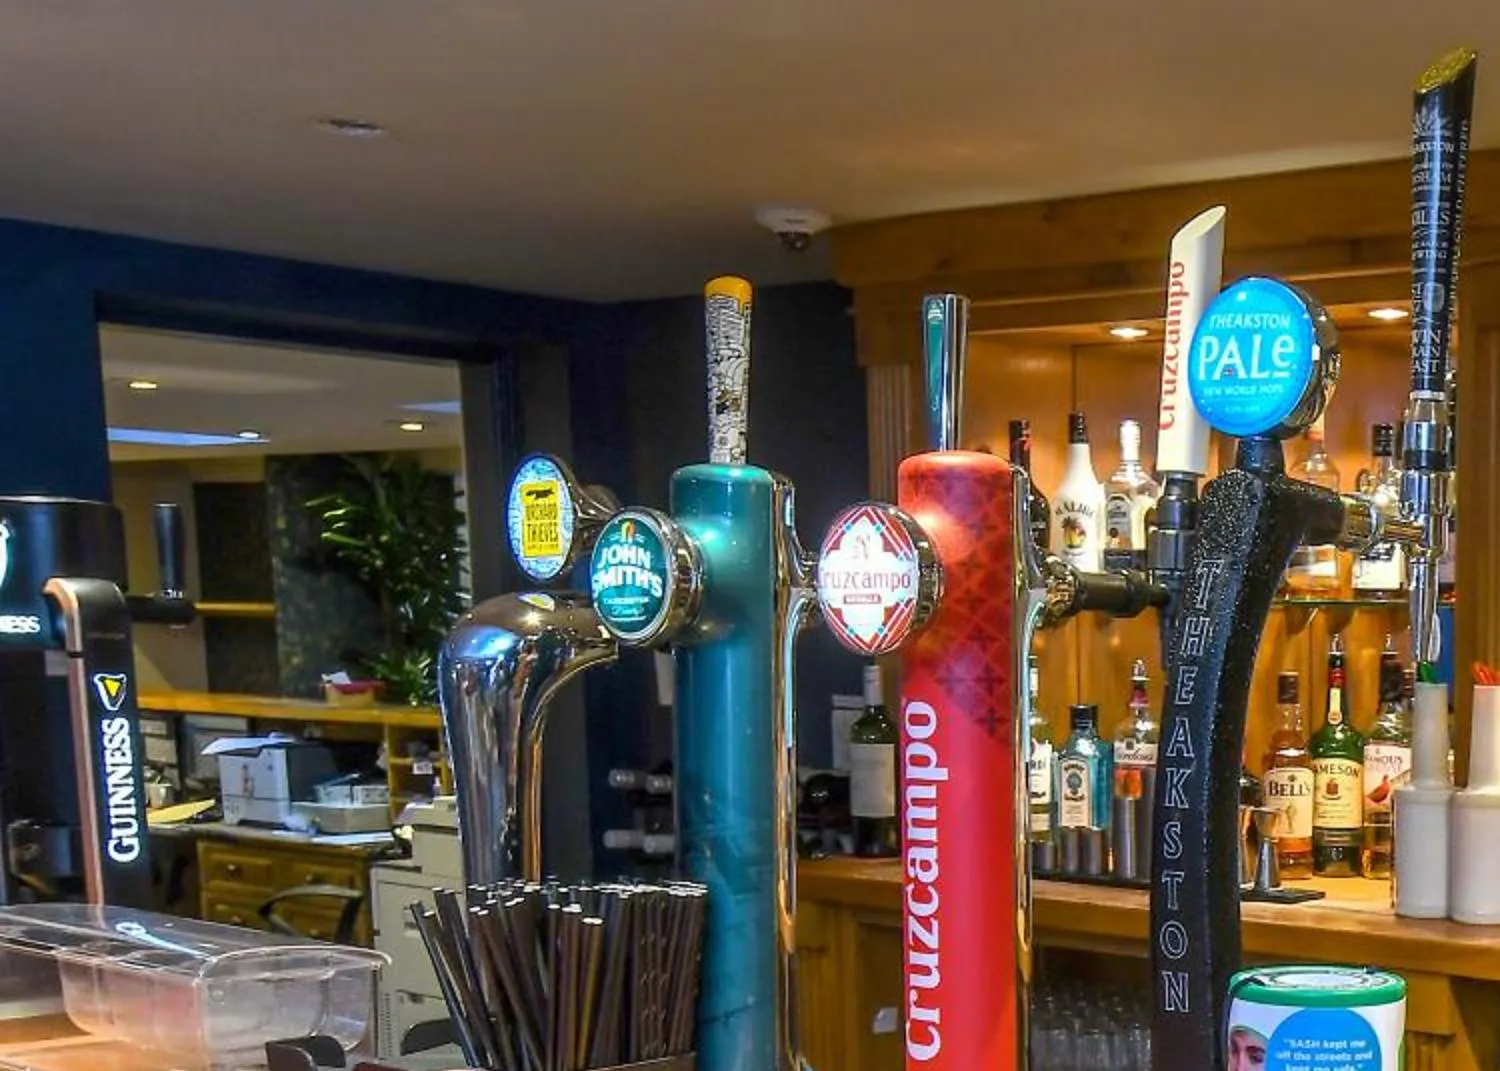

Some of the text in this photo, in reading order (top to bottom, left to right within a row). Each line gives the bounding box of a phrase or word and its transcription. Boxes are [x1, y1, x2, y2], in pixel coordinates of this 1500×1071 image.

[1209, 312, 1292, 331] THEAKSTON
[1158, 261, 1190, 431] Cruzcampo
[597, 544, 651, 570] JOHN
[591, 565, 664, 599] SMITH'S
[822, 570, 911, 592] ruzcampo
[1159, 558, 1225, 1013] THEAKSTON
[1313, 763, 1360, 778] AMESON
[101, 717, 141, 863] GUINNESS
[1268, 780, 1312, 798] BELL'S
[903, 701, 949, 1062] Cruzcampo
